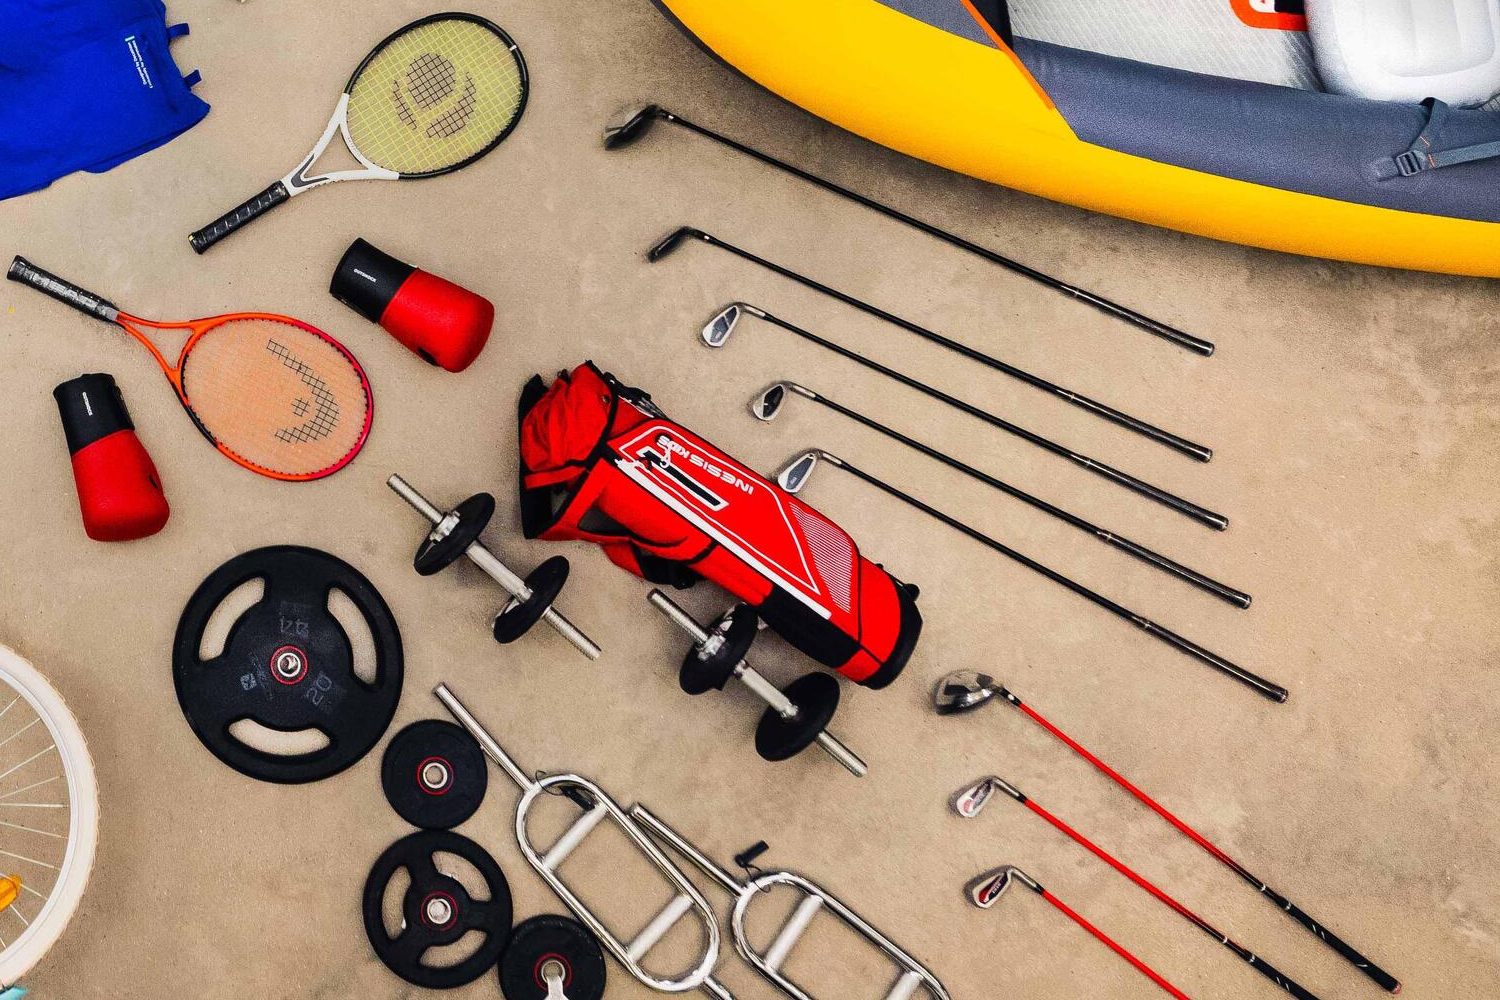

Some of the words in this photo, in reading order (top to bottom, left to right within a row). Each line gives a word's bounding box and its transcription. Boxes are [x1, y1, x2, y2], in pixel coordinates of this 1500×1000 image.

[657, 434, 690, 459] KIDS
[689, 453, 754, 495] INESIS
[306, 672, 333, 706] 20
